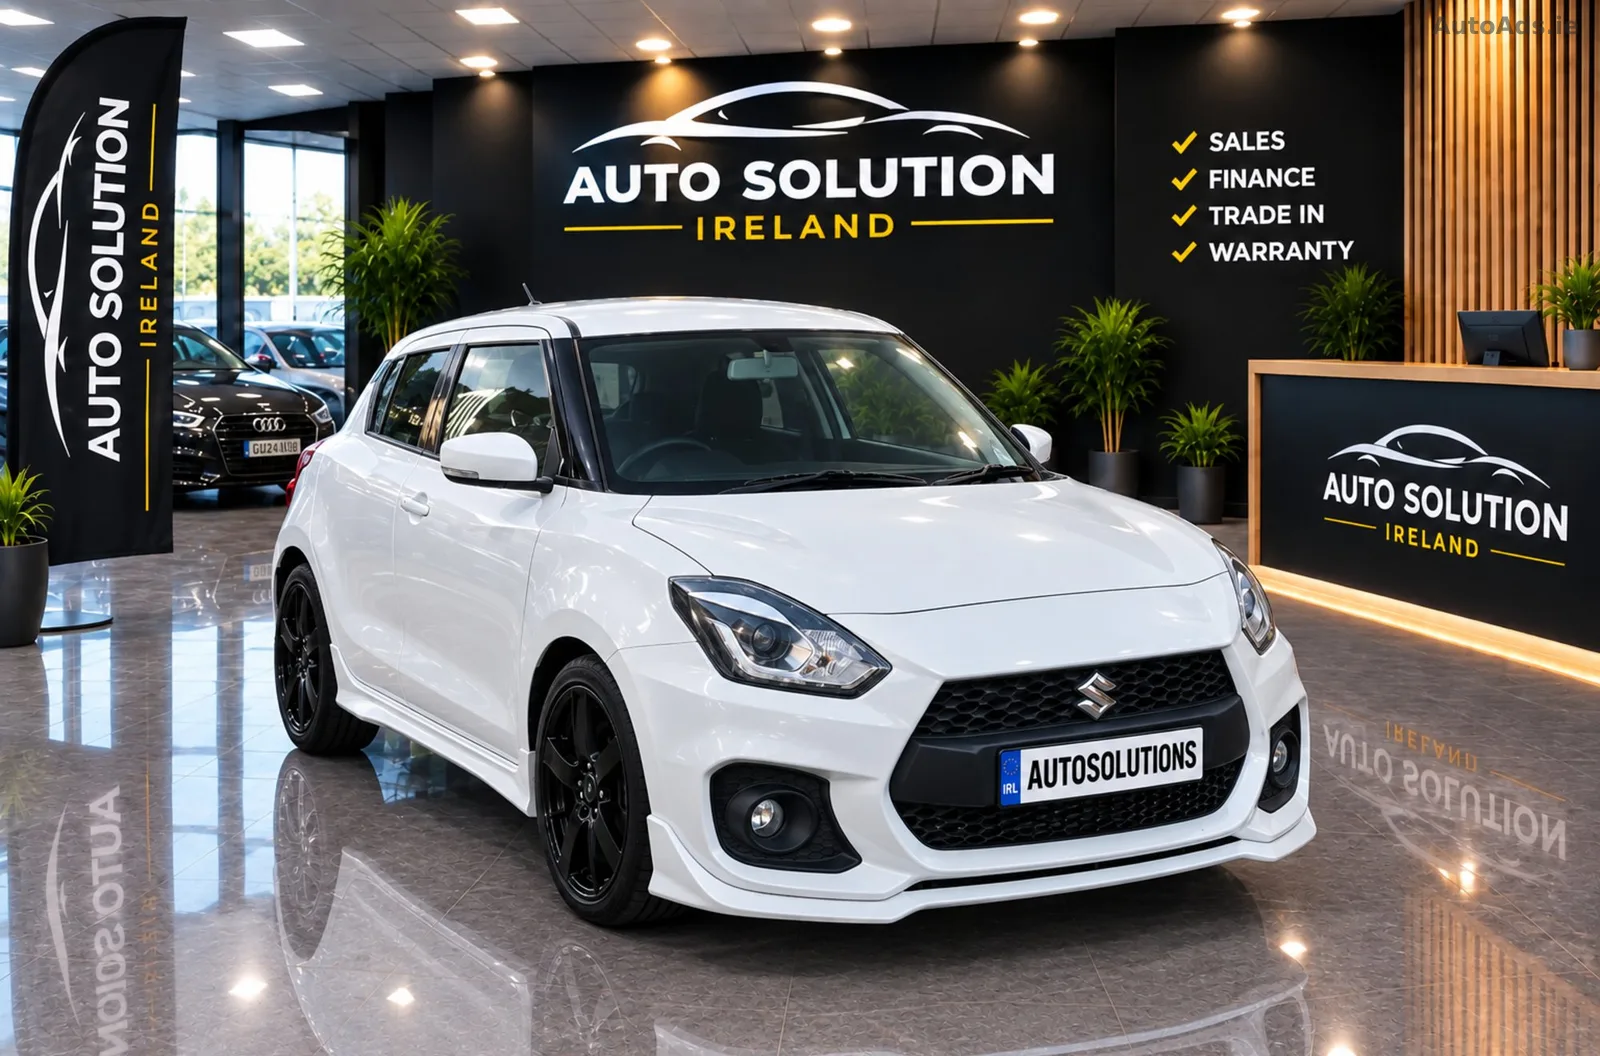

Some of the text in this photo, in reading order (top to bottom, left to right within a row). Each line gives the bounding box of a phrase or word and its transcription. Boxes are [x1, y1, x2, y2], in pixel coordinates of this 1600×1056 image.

[1209, 130, 1286, 152] SALES
[563, 154, 1055, 205] AUTO SOLUTION
[1209, 166, 1316, 190] FINANCE
[696, 213, 895, 241] IRELAND
[1209, 203, 1324, 226] TRADE IN
[1209, 240, 1355, 262] WARRANTY
[88, 97, 130, 463] AUTO SOLUTION
[139, 202, 160, 347] IRELAND
[1322, 471, 1569, 542] AUTO SOLUTION
[1385, 522, 1479, 558] IRELAND
[1027, 740, 1197, 791] AUTOSOLUTIONS
[1002, 783, 1019, 796] IRL
